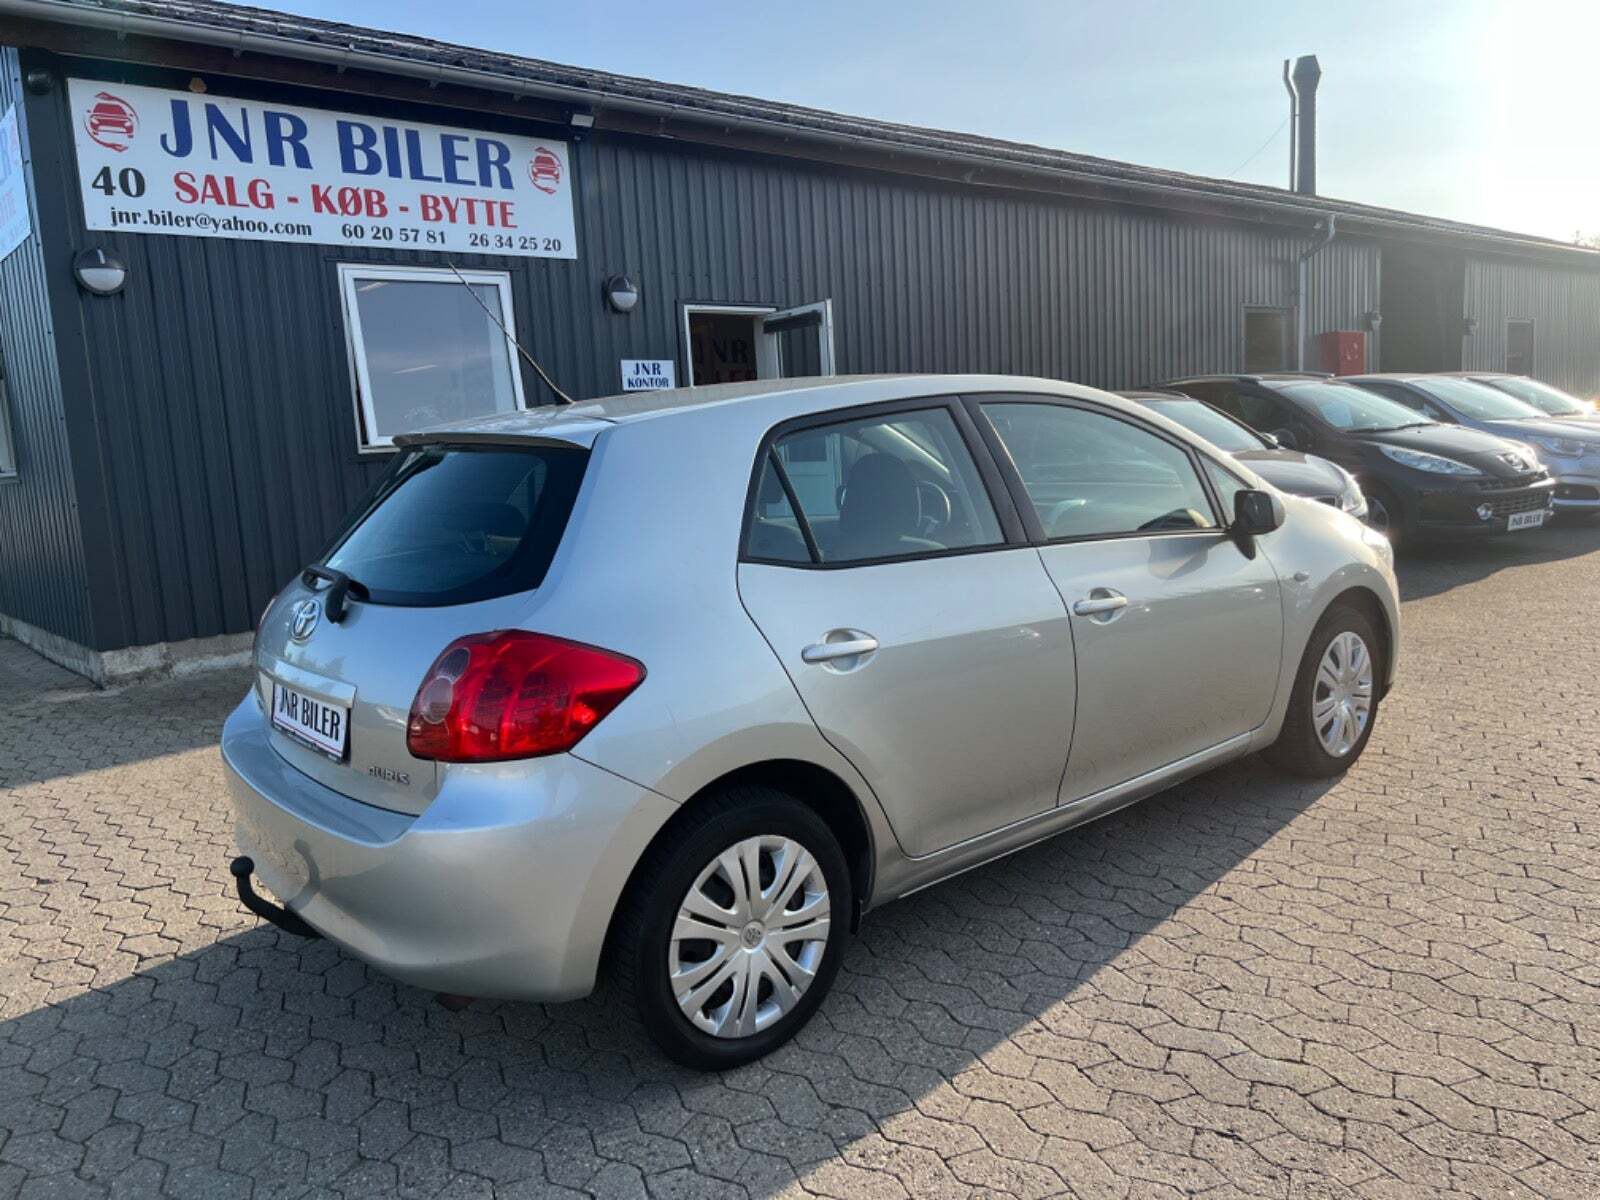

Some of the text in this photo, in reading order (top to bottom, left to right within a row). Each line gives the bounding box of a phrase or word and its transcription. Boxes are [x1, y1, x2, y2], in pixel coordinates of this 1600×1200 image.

[160, 98, 515, 190] JNR BILER
[91, 166, 146, 198] 40
[173, 170, 275, 209] SALG
[310, 183, 388, 218] KØB
[420, 194, 518, 229] BYTTE
[111, 206, 313, 236] jnr.biler@yahoo.com
[341, 223, 446, 244] 60 20 57 81
[469, 232, 562, 251] 26 34 25 20
[627, 377, 669, 388] KONTOR
[632, 362, 661, 376] JNR
[279, 687, 298, 721] JNR
[302, 697, 341, 742] BILER
